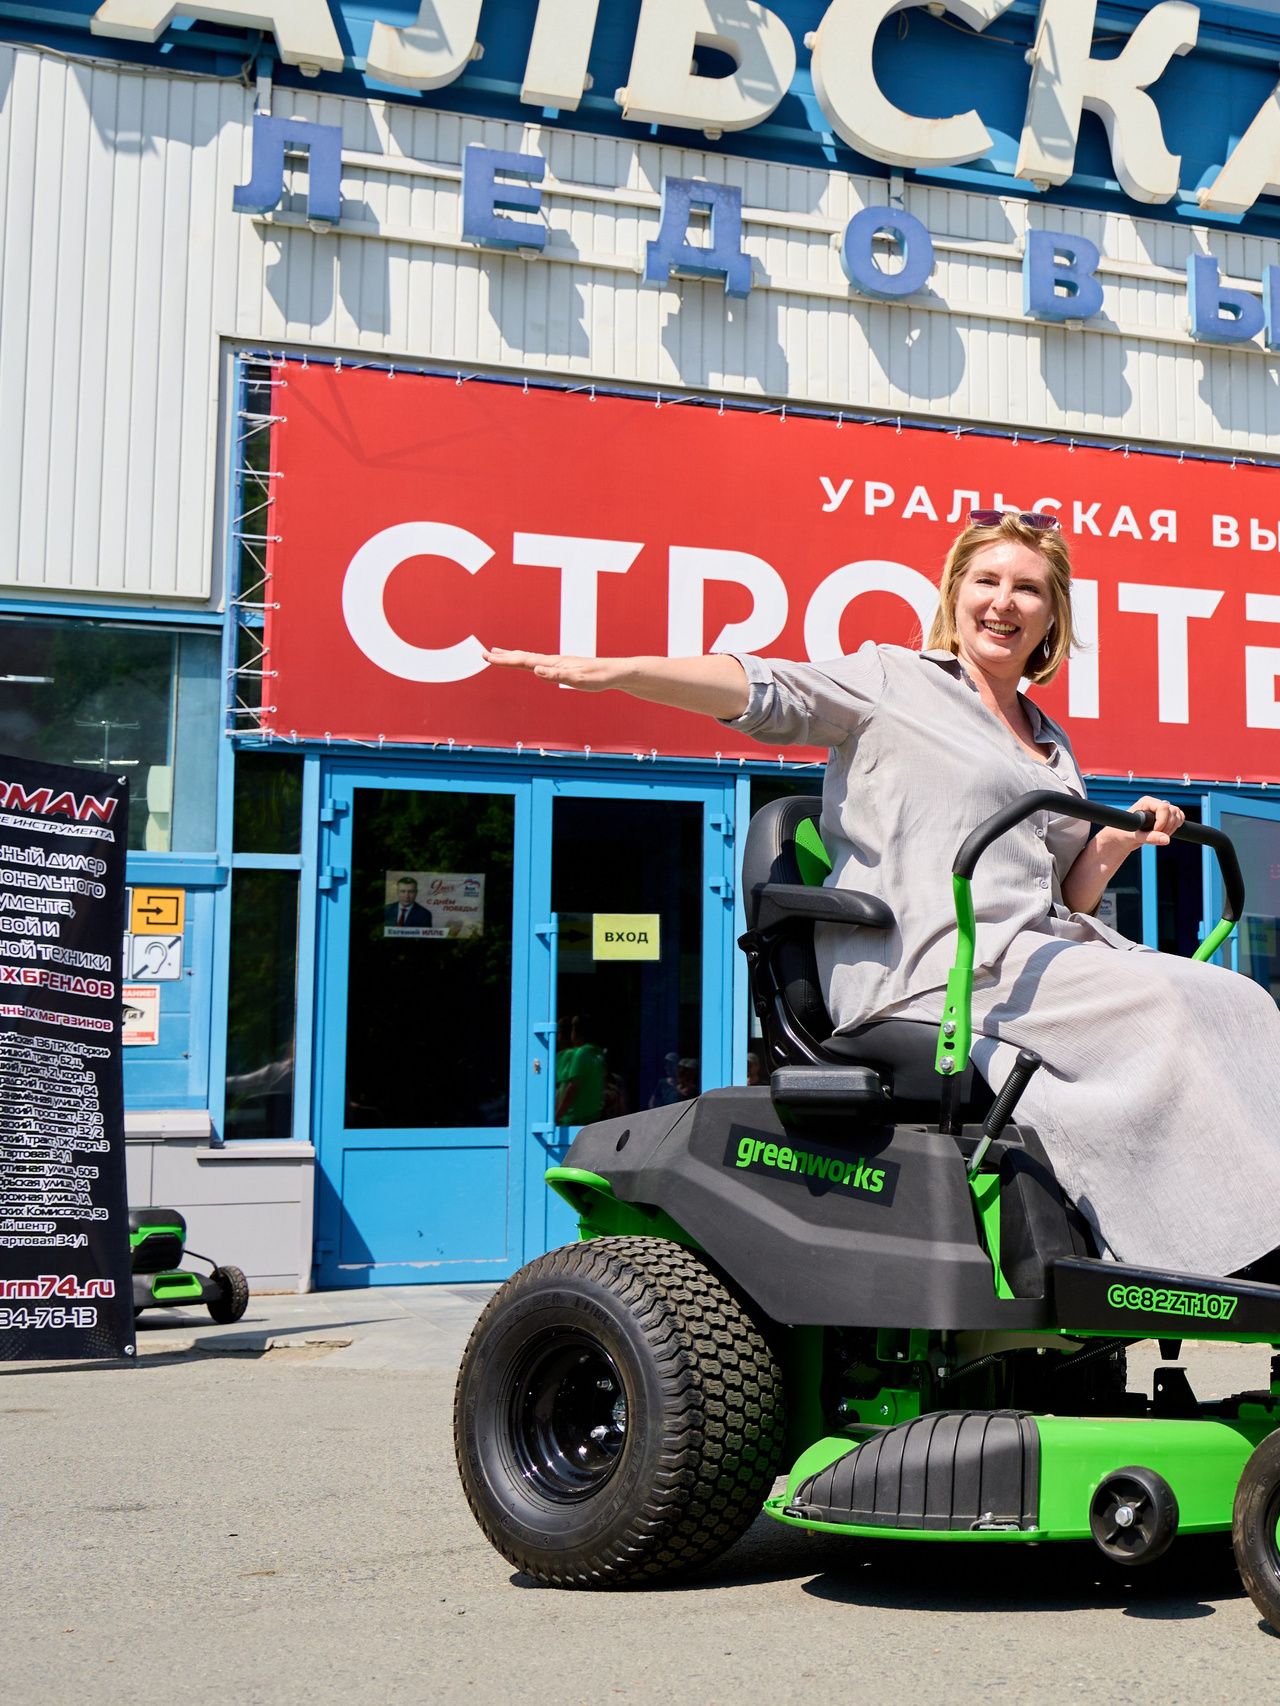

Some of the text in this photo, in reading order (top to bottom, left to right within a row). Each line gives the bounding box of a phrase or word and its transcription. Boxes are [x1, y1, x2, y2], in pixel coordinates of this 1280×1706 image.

[13, 817, 114, 841] ИНСТРУМЕНТА
[0, 845, 46, 867] ный
[0, 868, 106, 899] онального
[604, 931, 649, 944] ВХОД
[21, 967, 115, 1000] БРЕНДОВ
[38, 1009, 114, 1033] магазинов
[735, 1136, 886, 1193] greenworks
[15, 1221, 57, 1234] центр
[55, 1234, 89, 1249] 34/1
[1108, 1283, 1238, 1321] GC82ZT107
